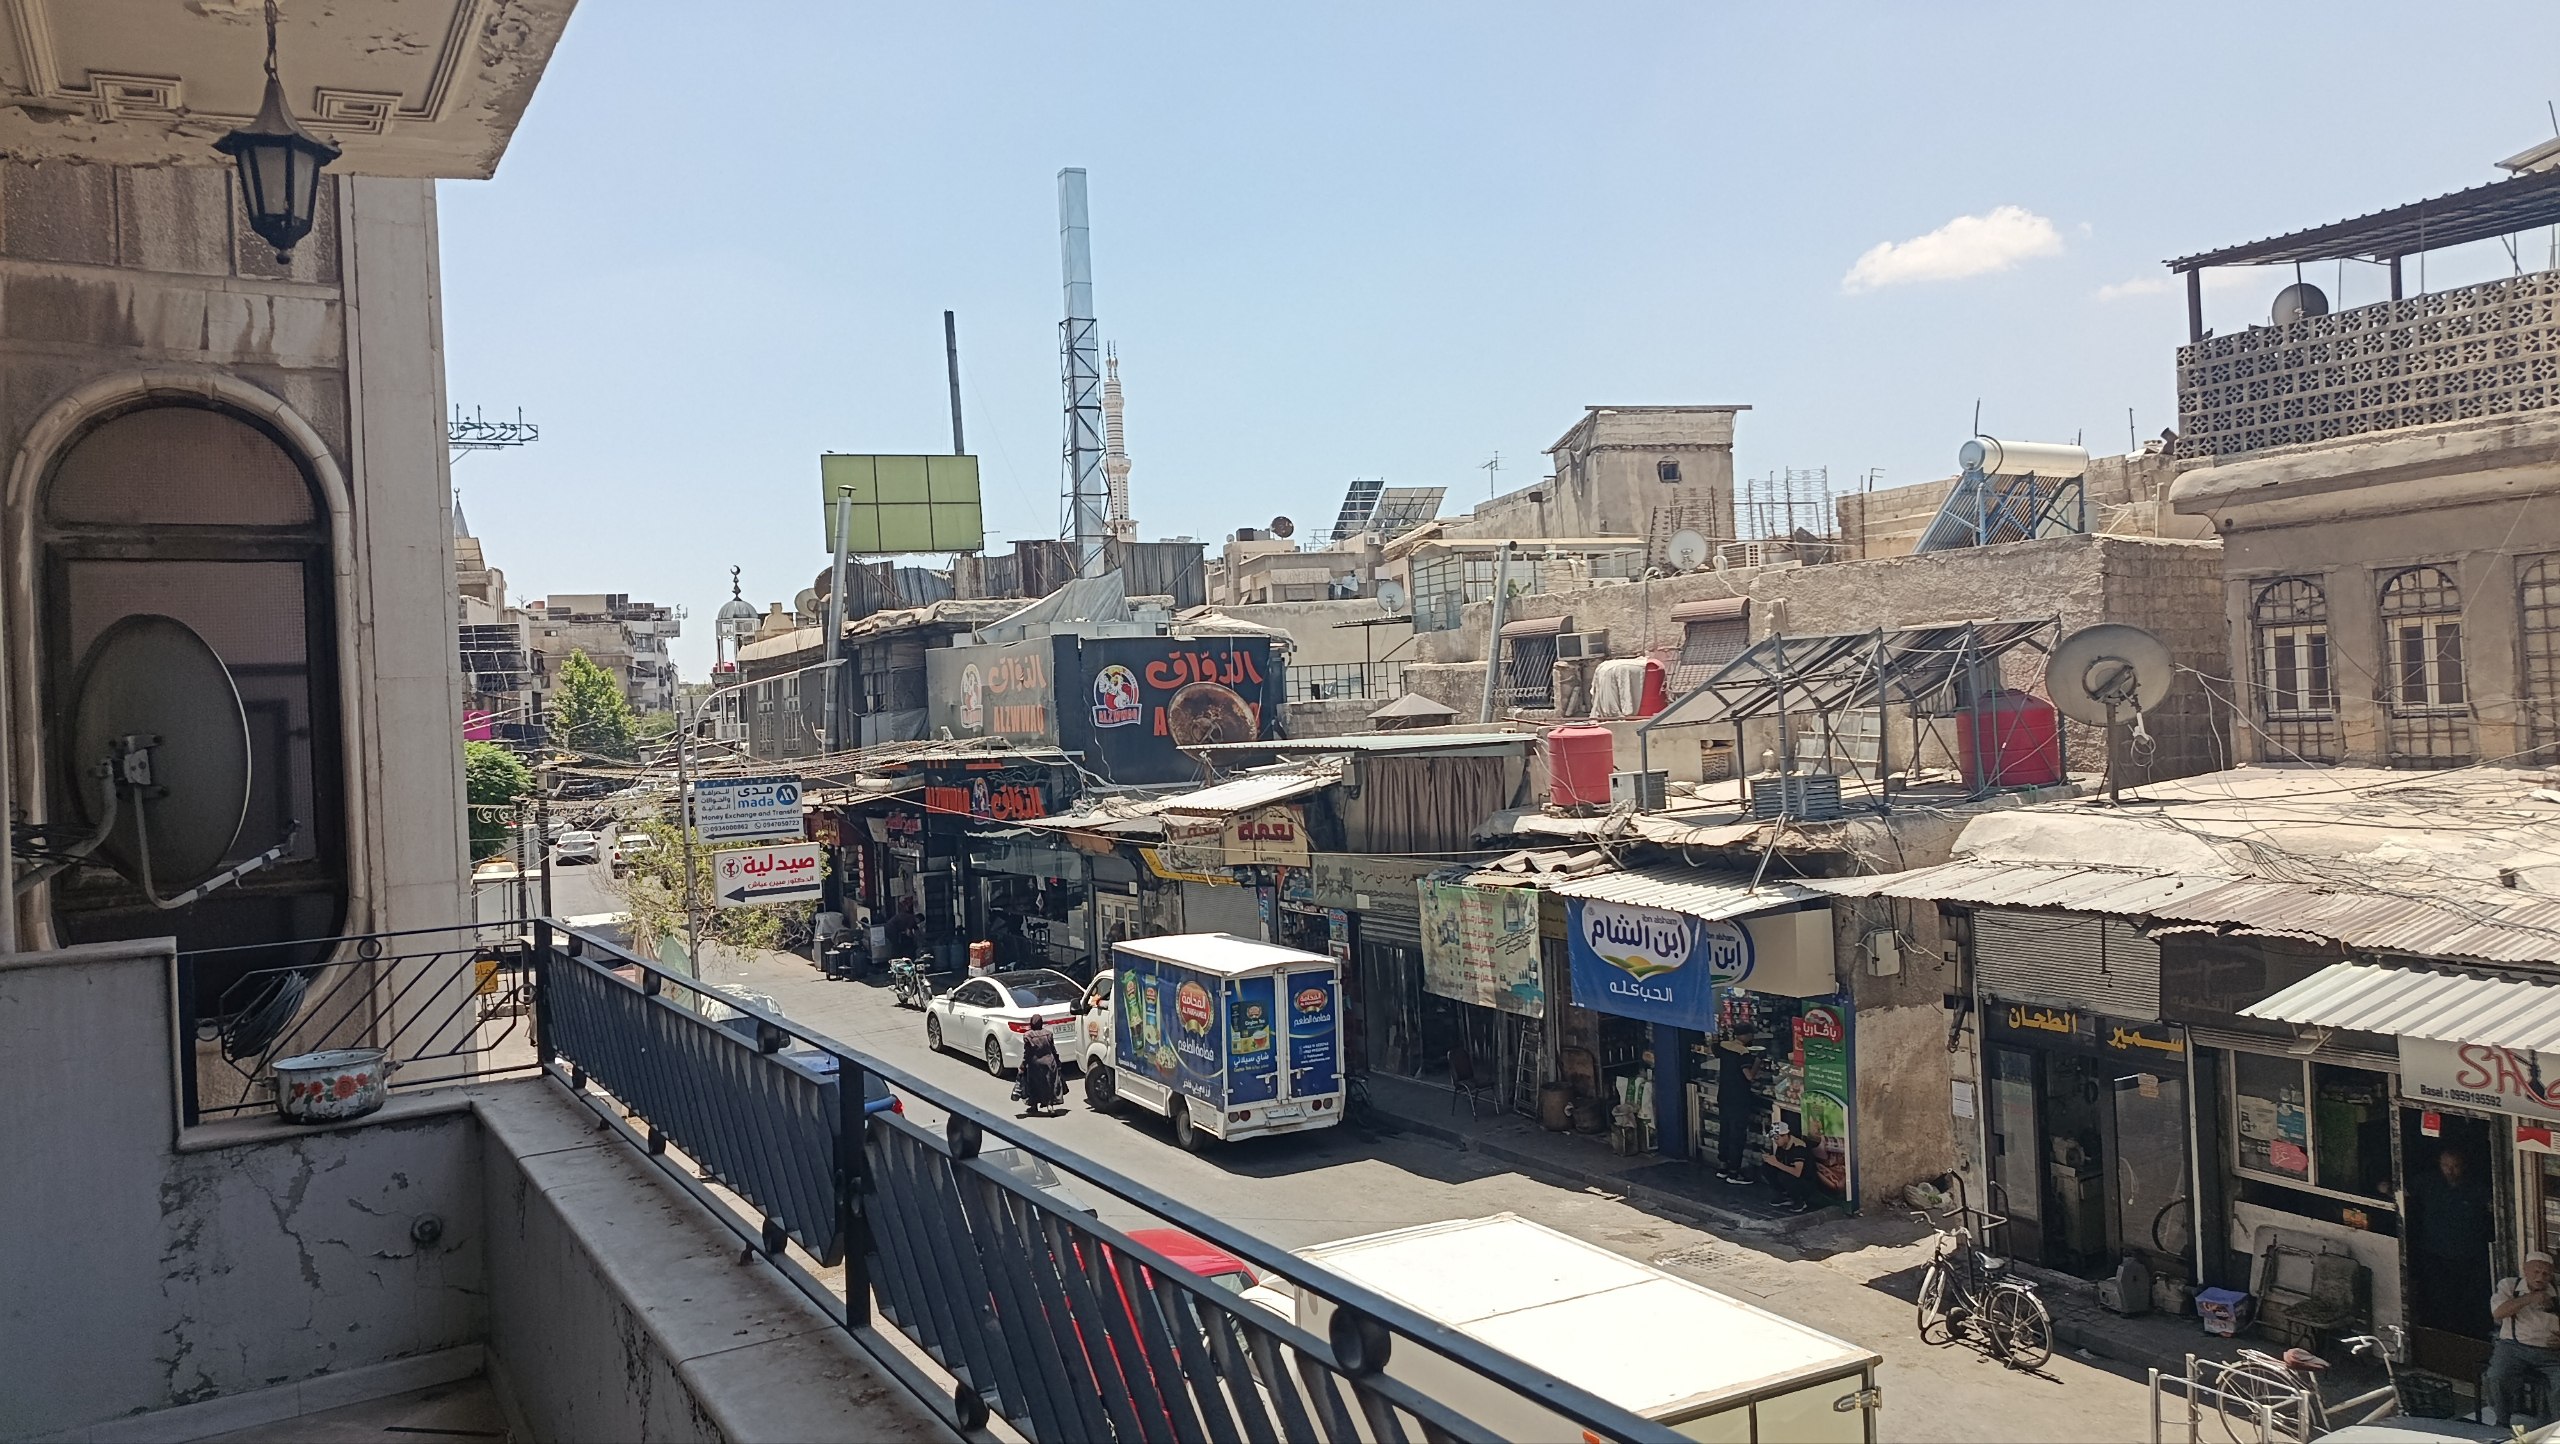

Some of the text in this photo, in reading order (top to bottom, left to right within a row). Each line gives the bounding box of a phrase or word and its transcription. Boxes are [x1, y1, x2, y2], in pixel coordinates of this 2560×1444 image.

[994, 704, 1044, 735] ALZWWAQ
[737, 786, 773, 798] مدى
[738, 796, 774, 808] mada
[701, 813, 723, 821] Money
[725, 811, 757, 820] Exchange
[743, 853, 815, 877] صيدلية
[787, 875, 814, 885] الدكتور
[1642, 913, 1678, 926] ibn alsham
[1591, 914, 1650, 949] الشام
[1654, 924, 1686, 959] ابن
[1715, 941, 1741, 970] ابن
[1181, 991, 1206, 1009] الفخامة
[1609, 980, 1673, 1003] الحب كله
[2008, 1004, 2185, 1053] سمير الطحان
[1177, 1038, 1214, 1061] فخامة الطعم
[1255, 1051, 1270, 1065] شاي
[1233, 1055, 1255, 1068] سيلاني
[2420, 1084, 2444, 1098] Basel
